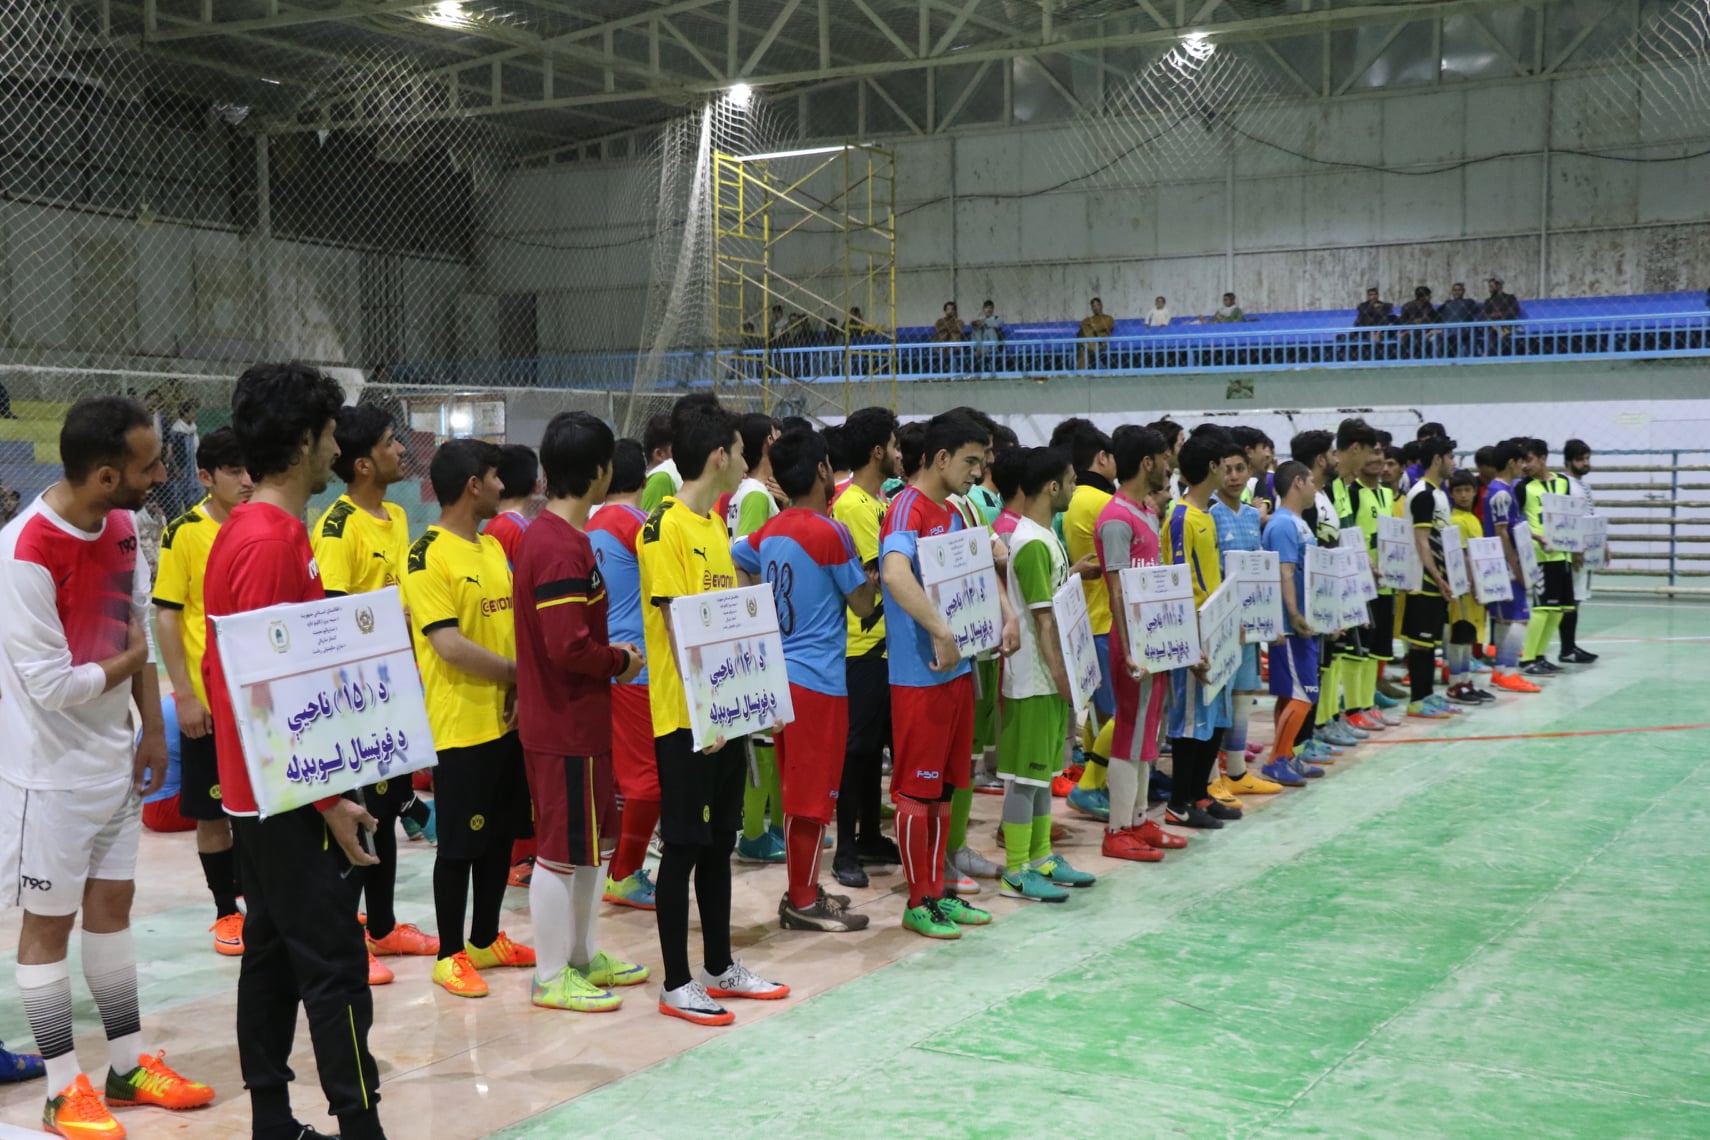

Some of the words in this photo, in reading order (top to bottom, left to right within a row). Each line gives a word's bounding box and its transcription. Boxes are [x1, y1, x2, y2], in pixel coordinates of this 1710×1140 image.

[378, 681, 388, 700] د
[398, 729, 407, 748] د
[21, 874, 52, 891] T90
[719, 975, 740, 990] CR7
[128, 1067, 174, 1098] NIKE
